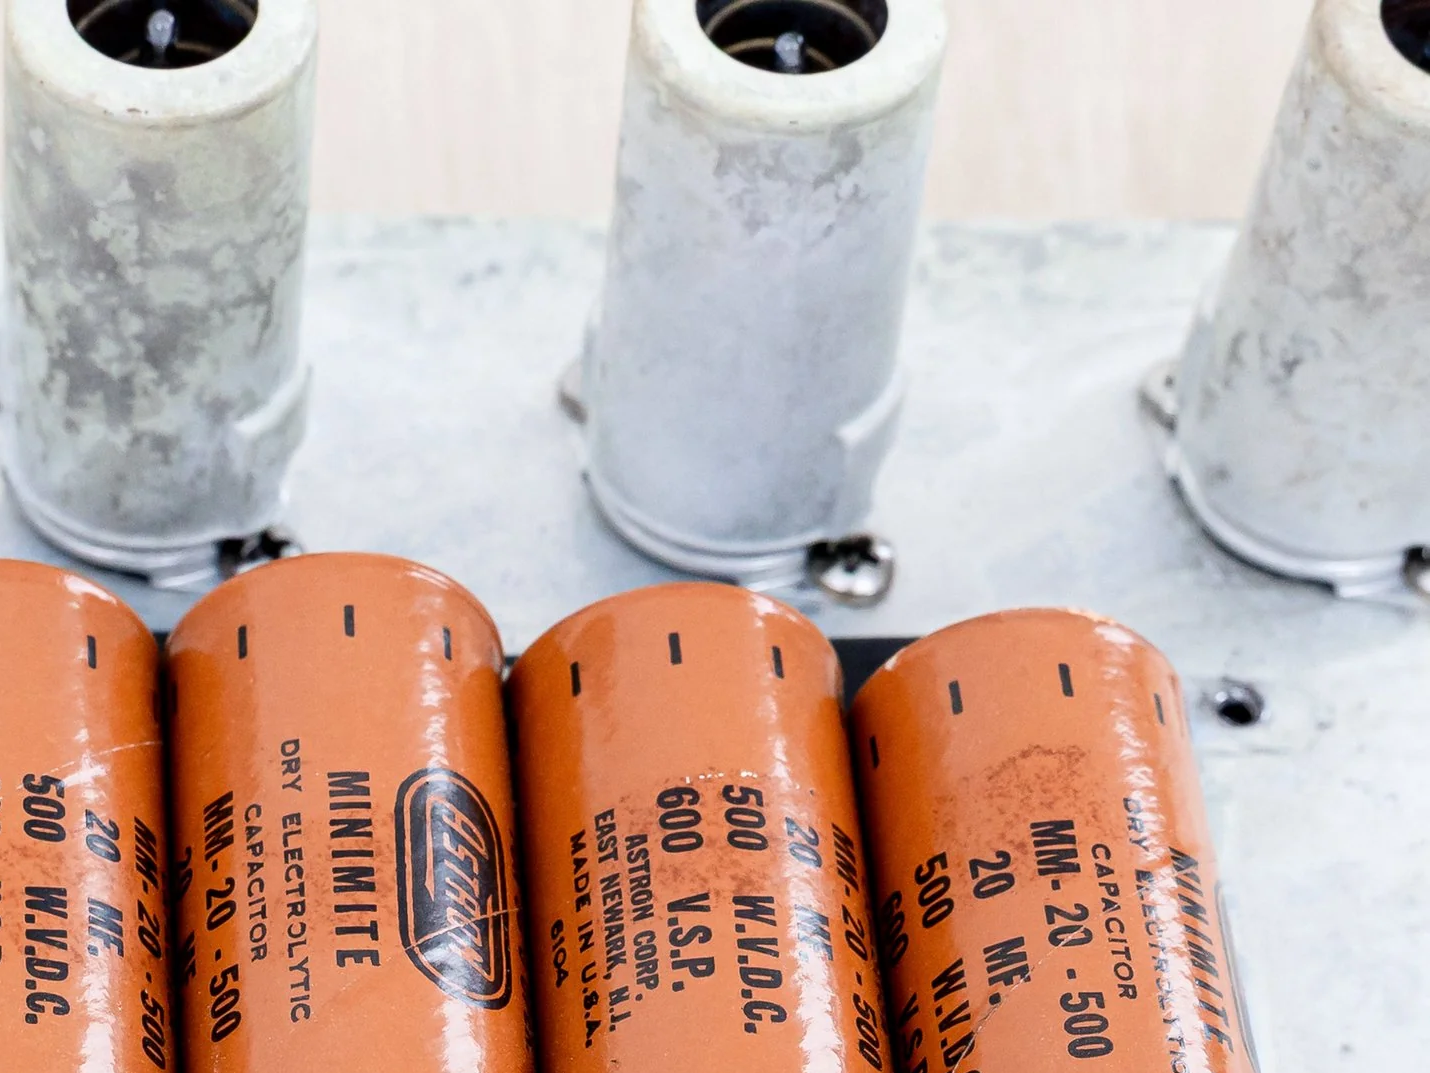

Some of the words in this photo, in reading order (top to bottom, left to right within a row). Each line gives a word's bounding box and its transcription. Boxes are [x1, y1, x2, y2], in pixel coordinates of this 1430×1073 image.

[280, 738, 302, 792] DRY
[21, 773, 66, 843] 500
[84, 809, 121, 863] 20
[594, 808, 618, 862] EAST
[656, 787, 704, 853] 600
[722, 785, 769, 851] 500
[784, 817, 823, 868] 20
[1122, 797, 1150, 850] DRY
[244, 803, 268, 963] CAPACITOR
[327, 771, 380, 968] MINIMITE
[428, 797, 493, 982] ASTRON
[569, 829, 591, 913] MADE
[625, 834, 654, 923] ASTRON
[914, 851, 955, 929] 500
[968, 850, 1016, 900] 20
[24, 885, 70, 1025] W.V.D.C.
[86, 897, 124, 959] MF.
[282, 812, 311, 1023] ELECTROLYTIC
[576, 921, 594, 951] IN
[599, 873, 627, 980] NEWARK,
[667, 892, 715, 992] V.S.P.
[1091, 843, 1138, 1001] CAPACITOR
[1168, 846, 1234, 1054] MINIMITE
[633, 930, 659, 1002] CORP.
[732, 895, 787, 1034] W.V.D.C.
[982, 936, 1031, 1007] MF.
[579, 964, 601, 1049] U.S.A.
[608, 986, 631, 1032] N.J.
